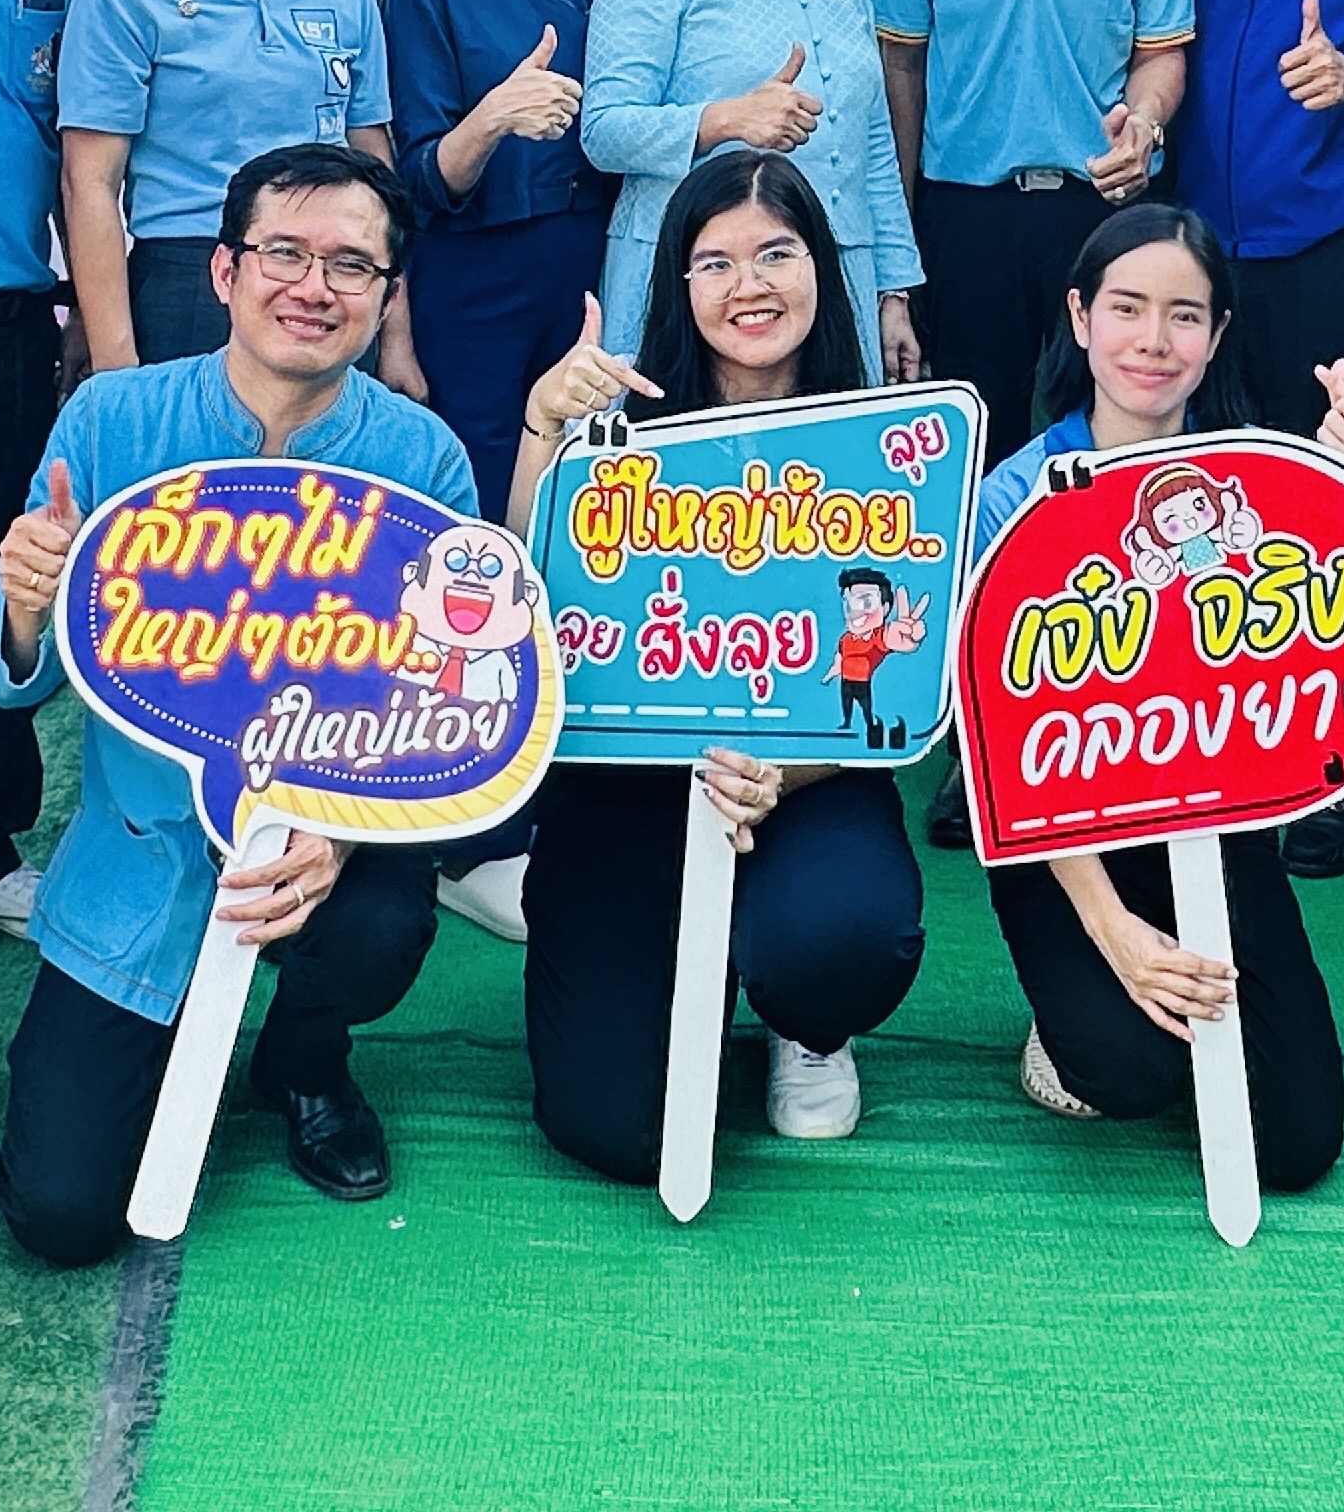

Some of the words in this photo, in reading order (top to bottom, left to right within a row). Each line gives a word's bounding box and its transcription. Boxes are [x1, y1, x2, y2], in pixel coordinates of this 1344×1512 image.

[886, 417, 946, 481] ลุย
[557, 611, 621, 669] ลุย
[640, 571, 815, 698] สั่งลุย
[1008, 560, 1152, 690] เจ๋ง
[240, 683, 508, 789] ผู้ใหญ่น้อย
